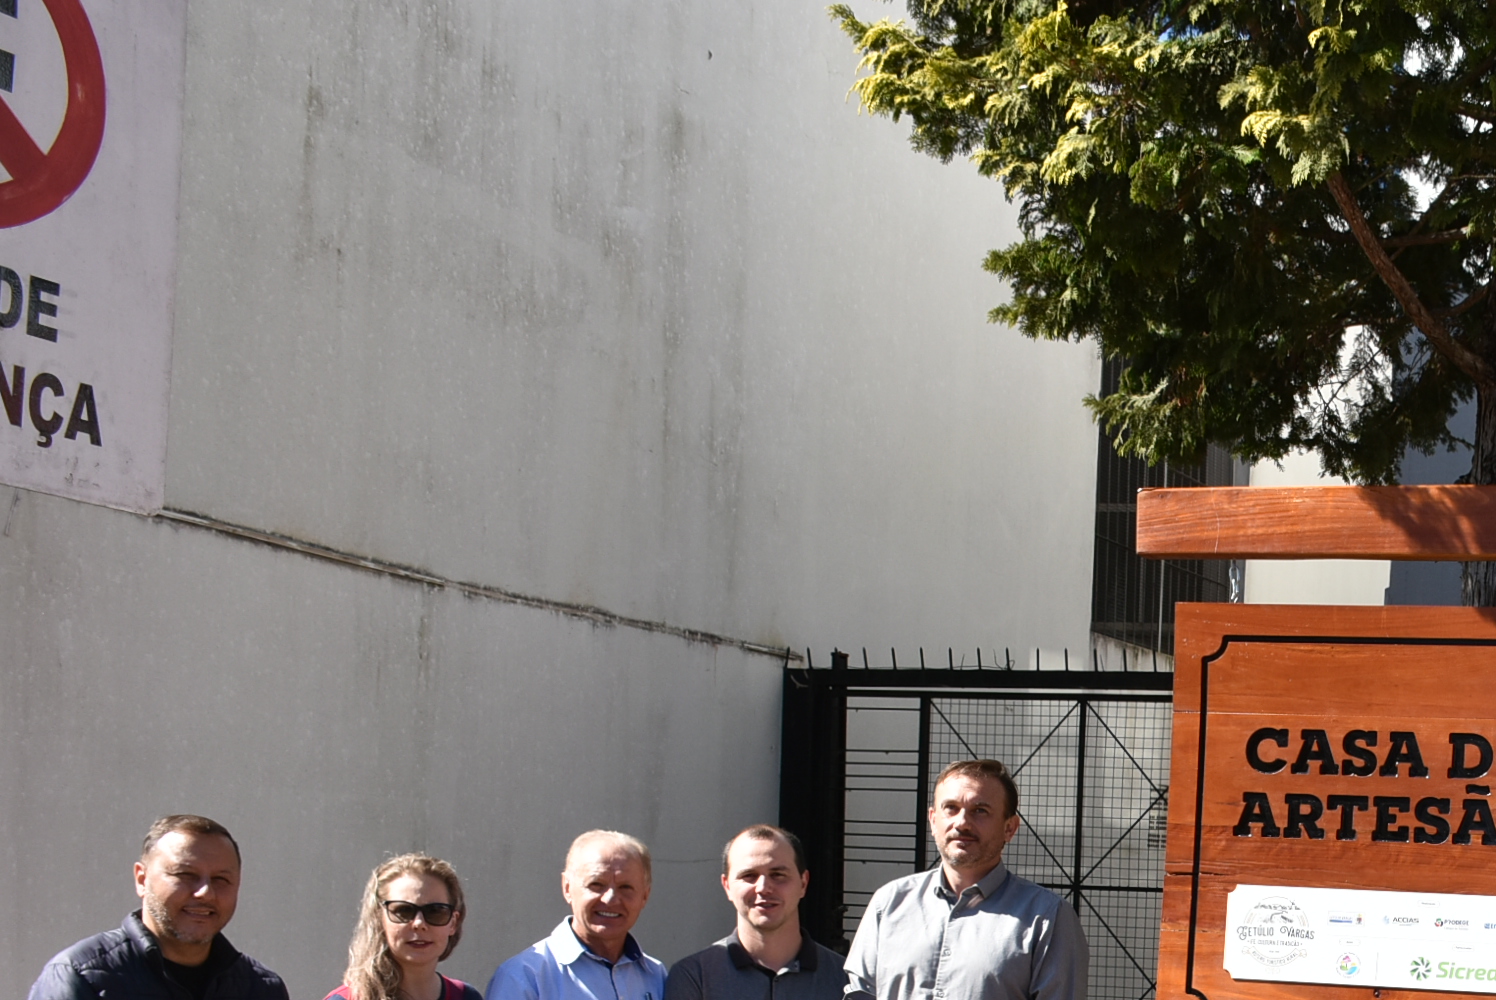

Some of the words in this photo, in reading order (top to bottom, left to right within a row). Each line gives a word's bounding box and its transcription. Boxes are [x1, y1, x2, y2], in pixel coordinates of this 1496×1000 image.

[1245, 727, 1429, 778] CASA
[1236, 924, 1274, 940] GETÚLIO
[1280, 925, 1315, 940] VARGAS
